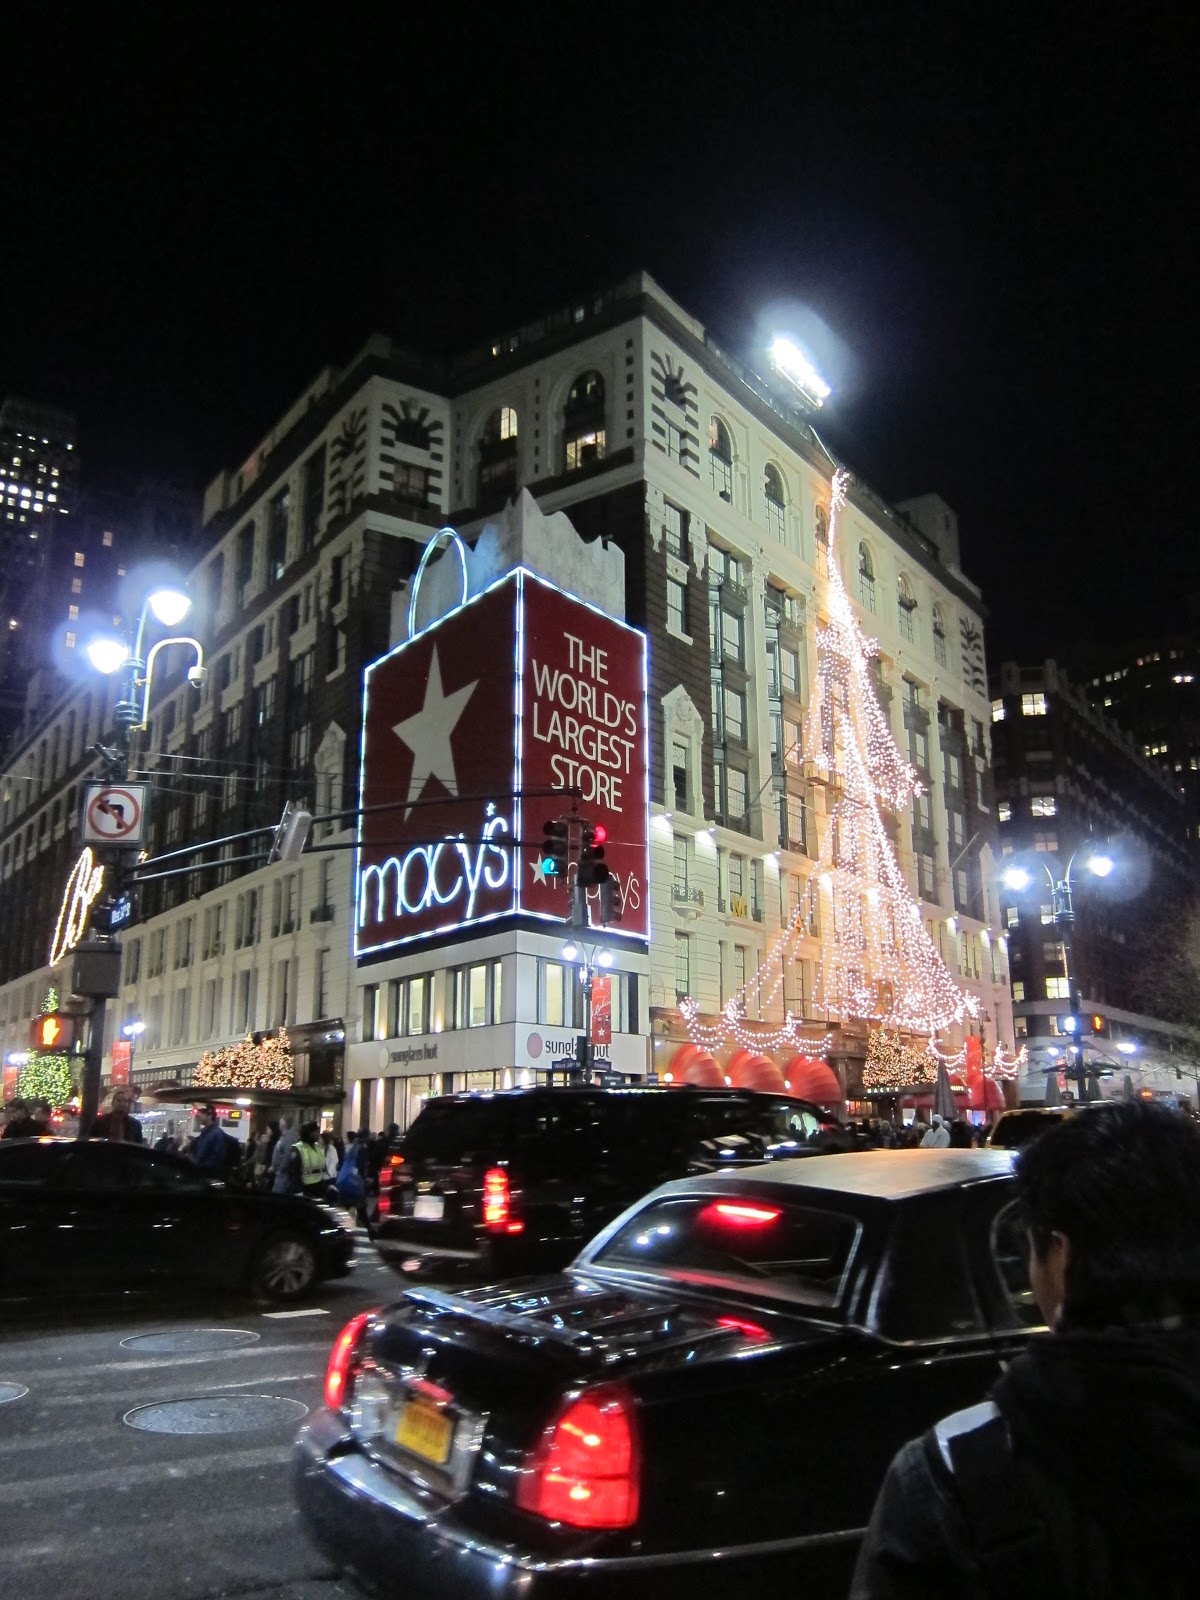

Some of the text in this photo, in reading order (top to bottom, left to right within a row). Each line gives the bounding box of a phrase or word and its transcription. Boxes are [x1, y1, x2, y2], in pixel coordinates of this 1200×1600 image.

[563, 632, 608, 685] THE
[532, 659, 637, 736] WORLD'S
[533, 702, 635, 775] LARGEST
[551, 754, 622, 812] STORE
[360, 802, 509, 927] macy's
[391, 1043, 438, 1067] sunglass hut
[545, 1037, 578, 1058] sungl
